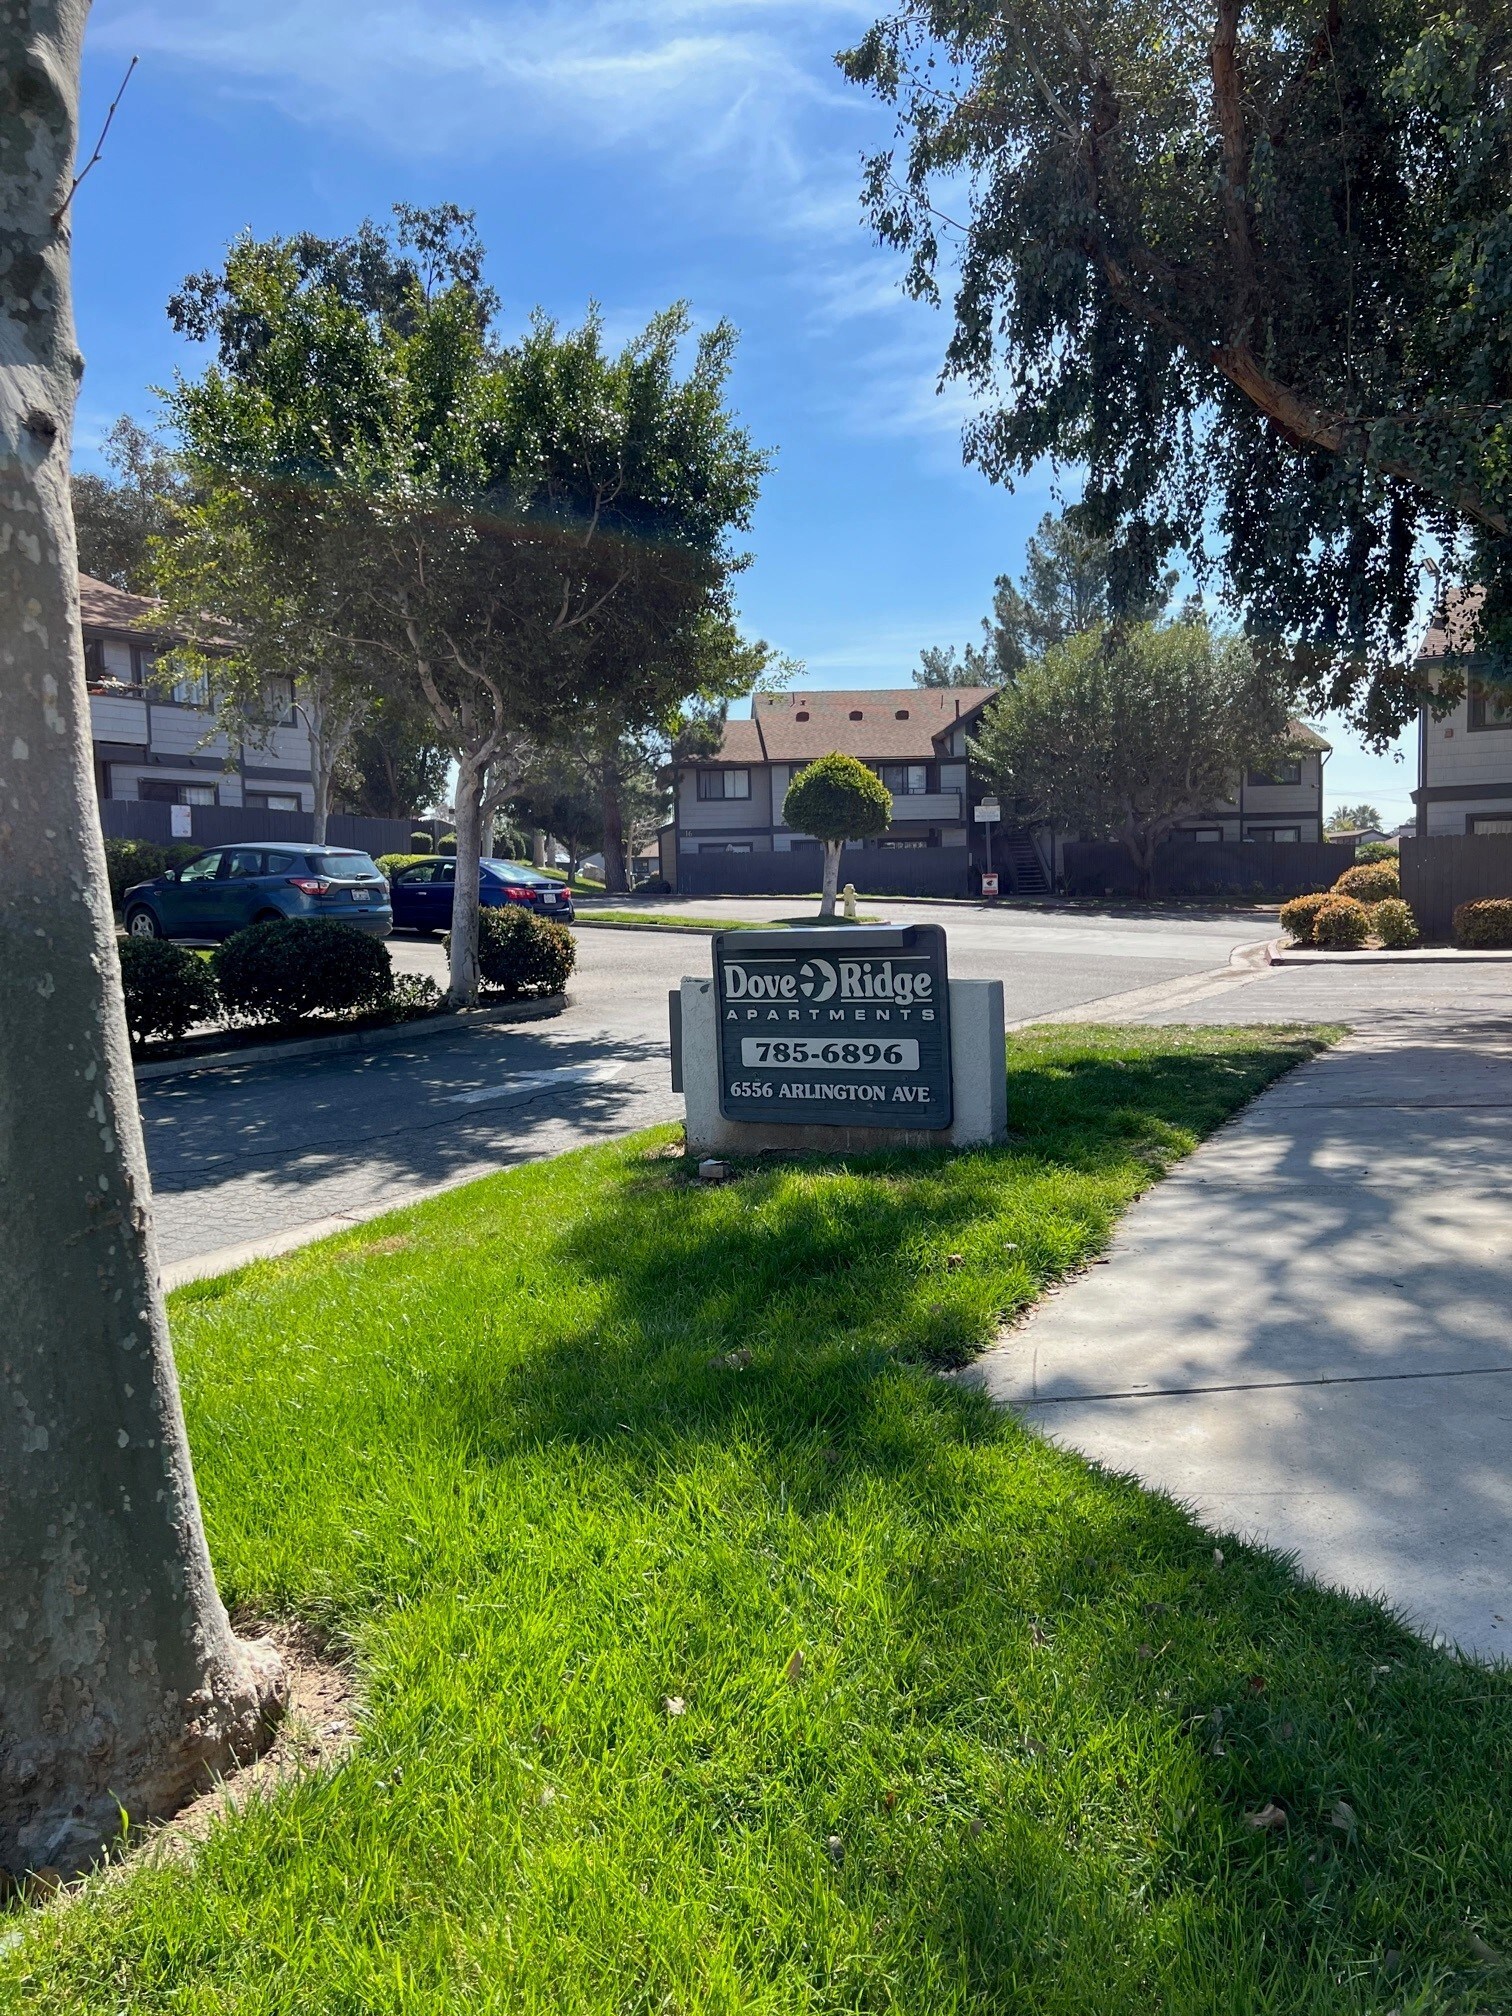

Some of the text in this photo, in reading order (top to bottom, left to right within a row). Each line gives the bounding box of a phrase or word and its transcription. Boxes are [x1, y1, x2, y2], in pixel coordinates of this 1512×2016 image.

[723, 961, 933, 1005] Dove Ridge
[726, 1009, 935, 1021] APARTMENTS
[755, 1042, 903, 1064] 785-6896
[730, 1082, 773, 1098] 6556
[778, 1083, 886, 1101] ARLINGTON
